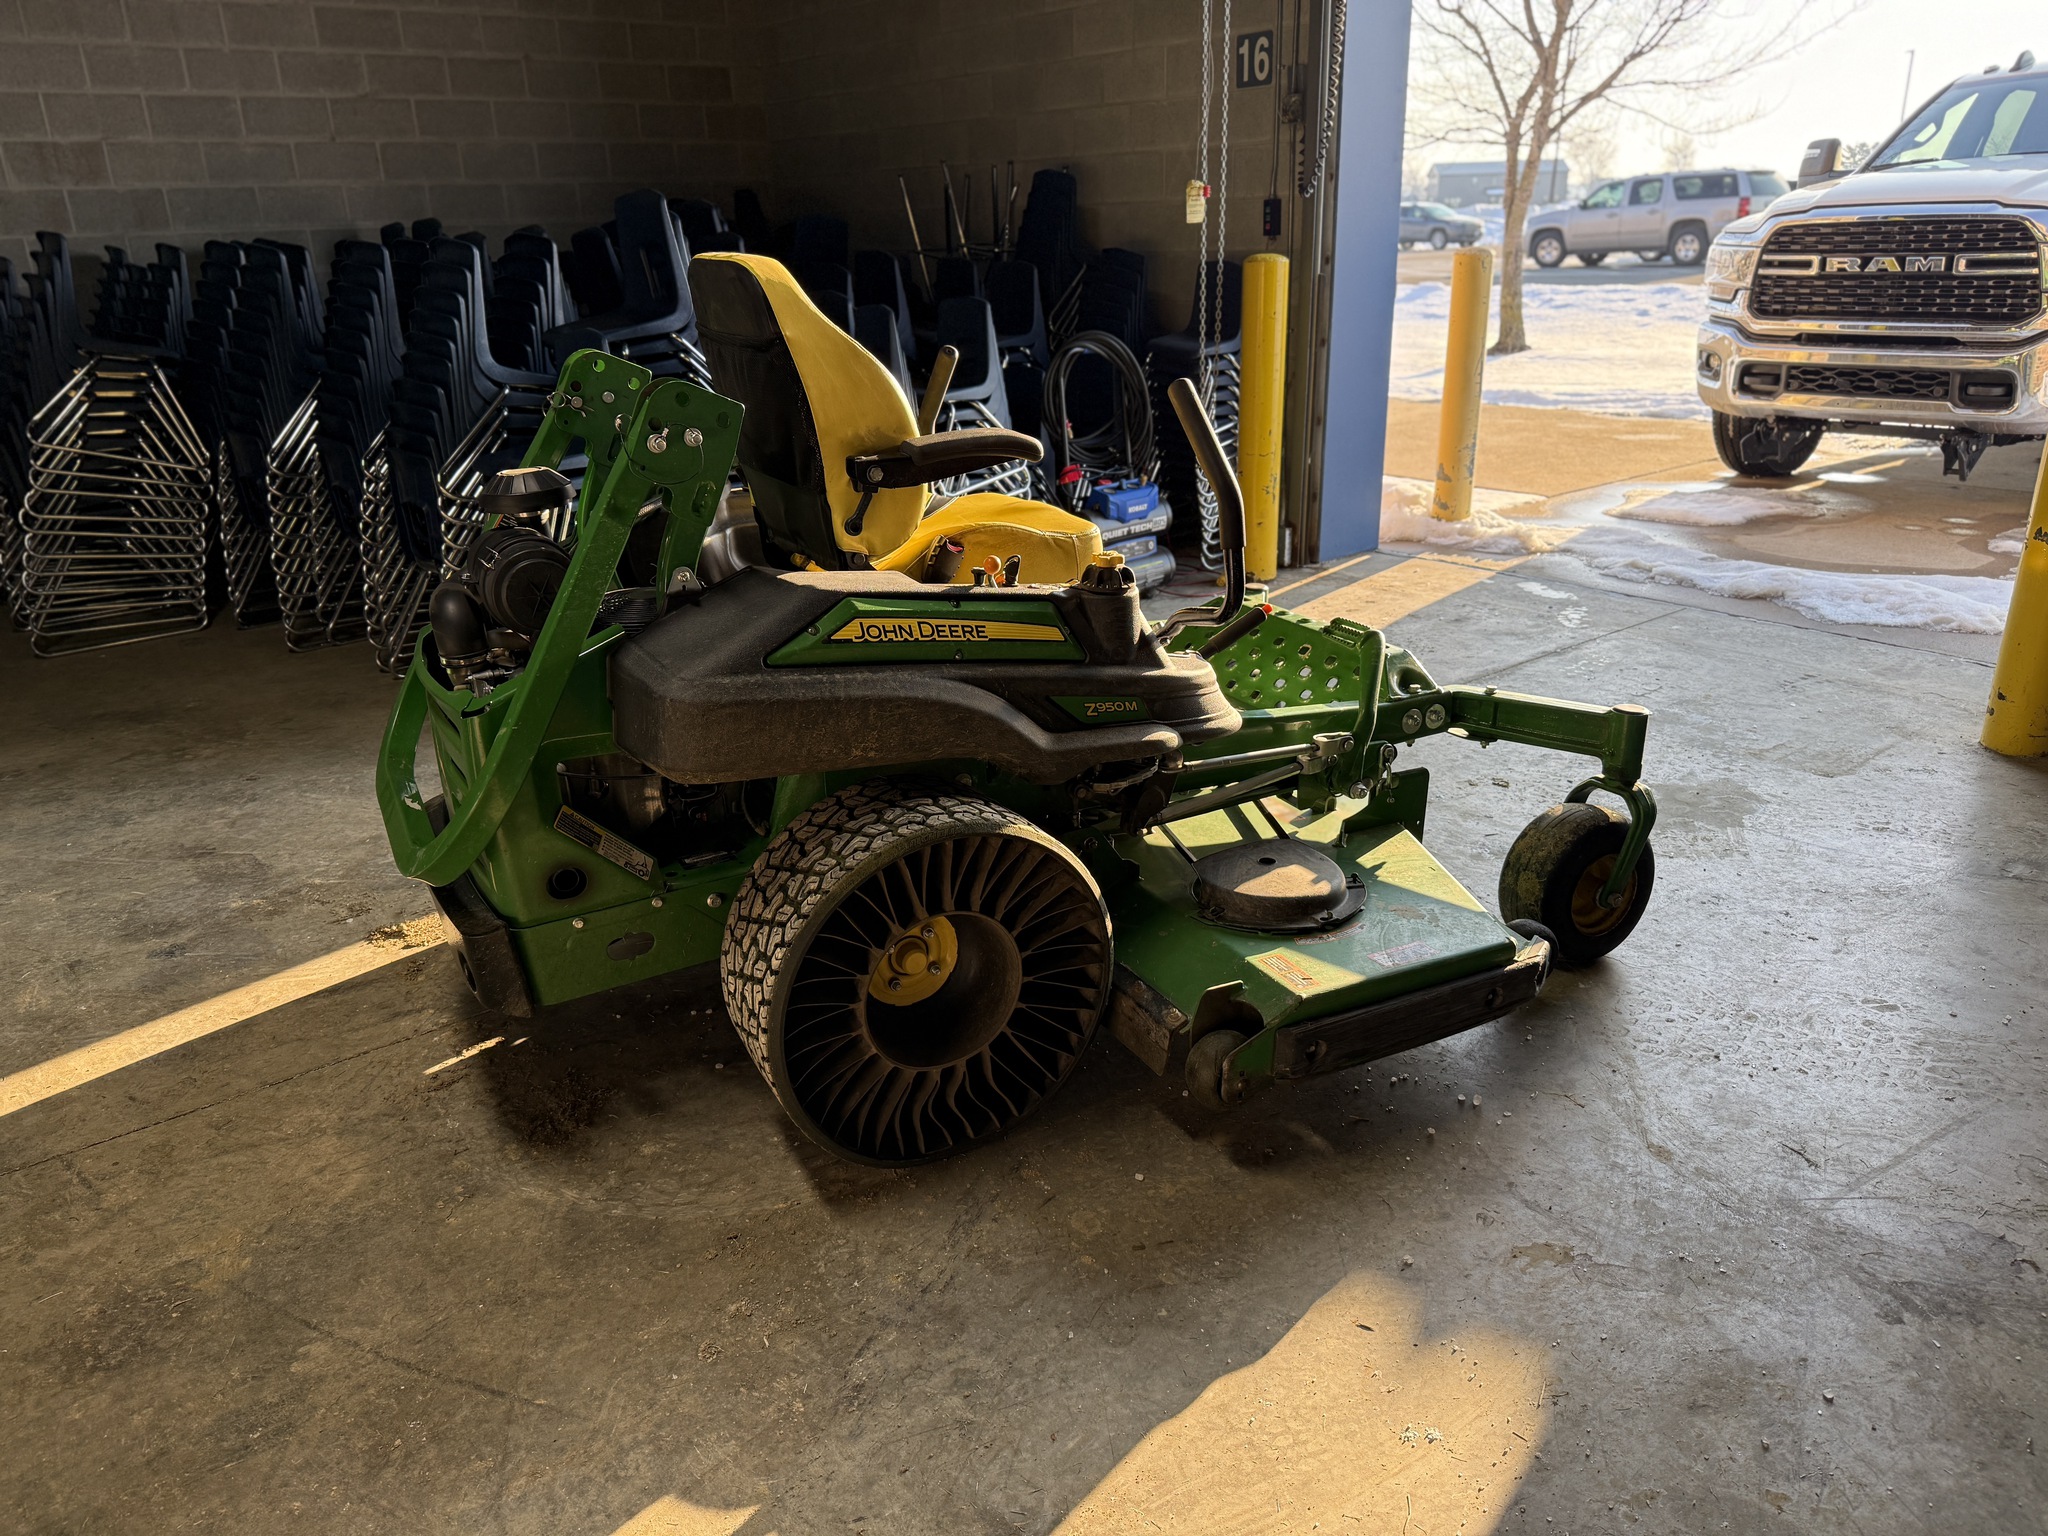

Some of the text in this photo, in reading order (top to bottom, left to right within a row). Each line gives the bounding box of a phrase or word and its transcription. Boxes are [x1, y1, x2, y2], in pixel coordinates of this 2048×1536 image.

[1239, 36, 1270, 82] 16
[1825, 256, 1946, 272] RAM
[1128, 504, 1148, 513] KOBALT
[1102, 527, 1129, 540] QUIET
[1130, 522, 1153, 534] TECH
[854, 621, 989, 640] JOHN DEERE
[1084, 701, 1138, 716] Z950M
